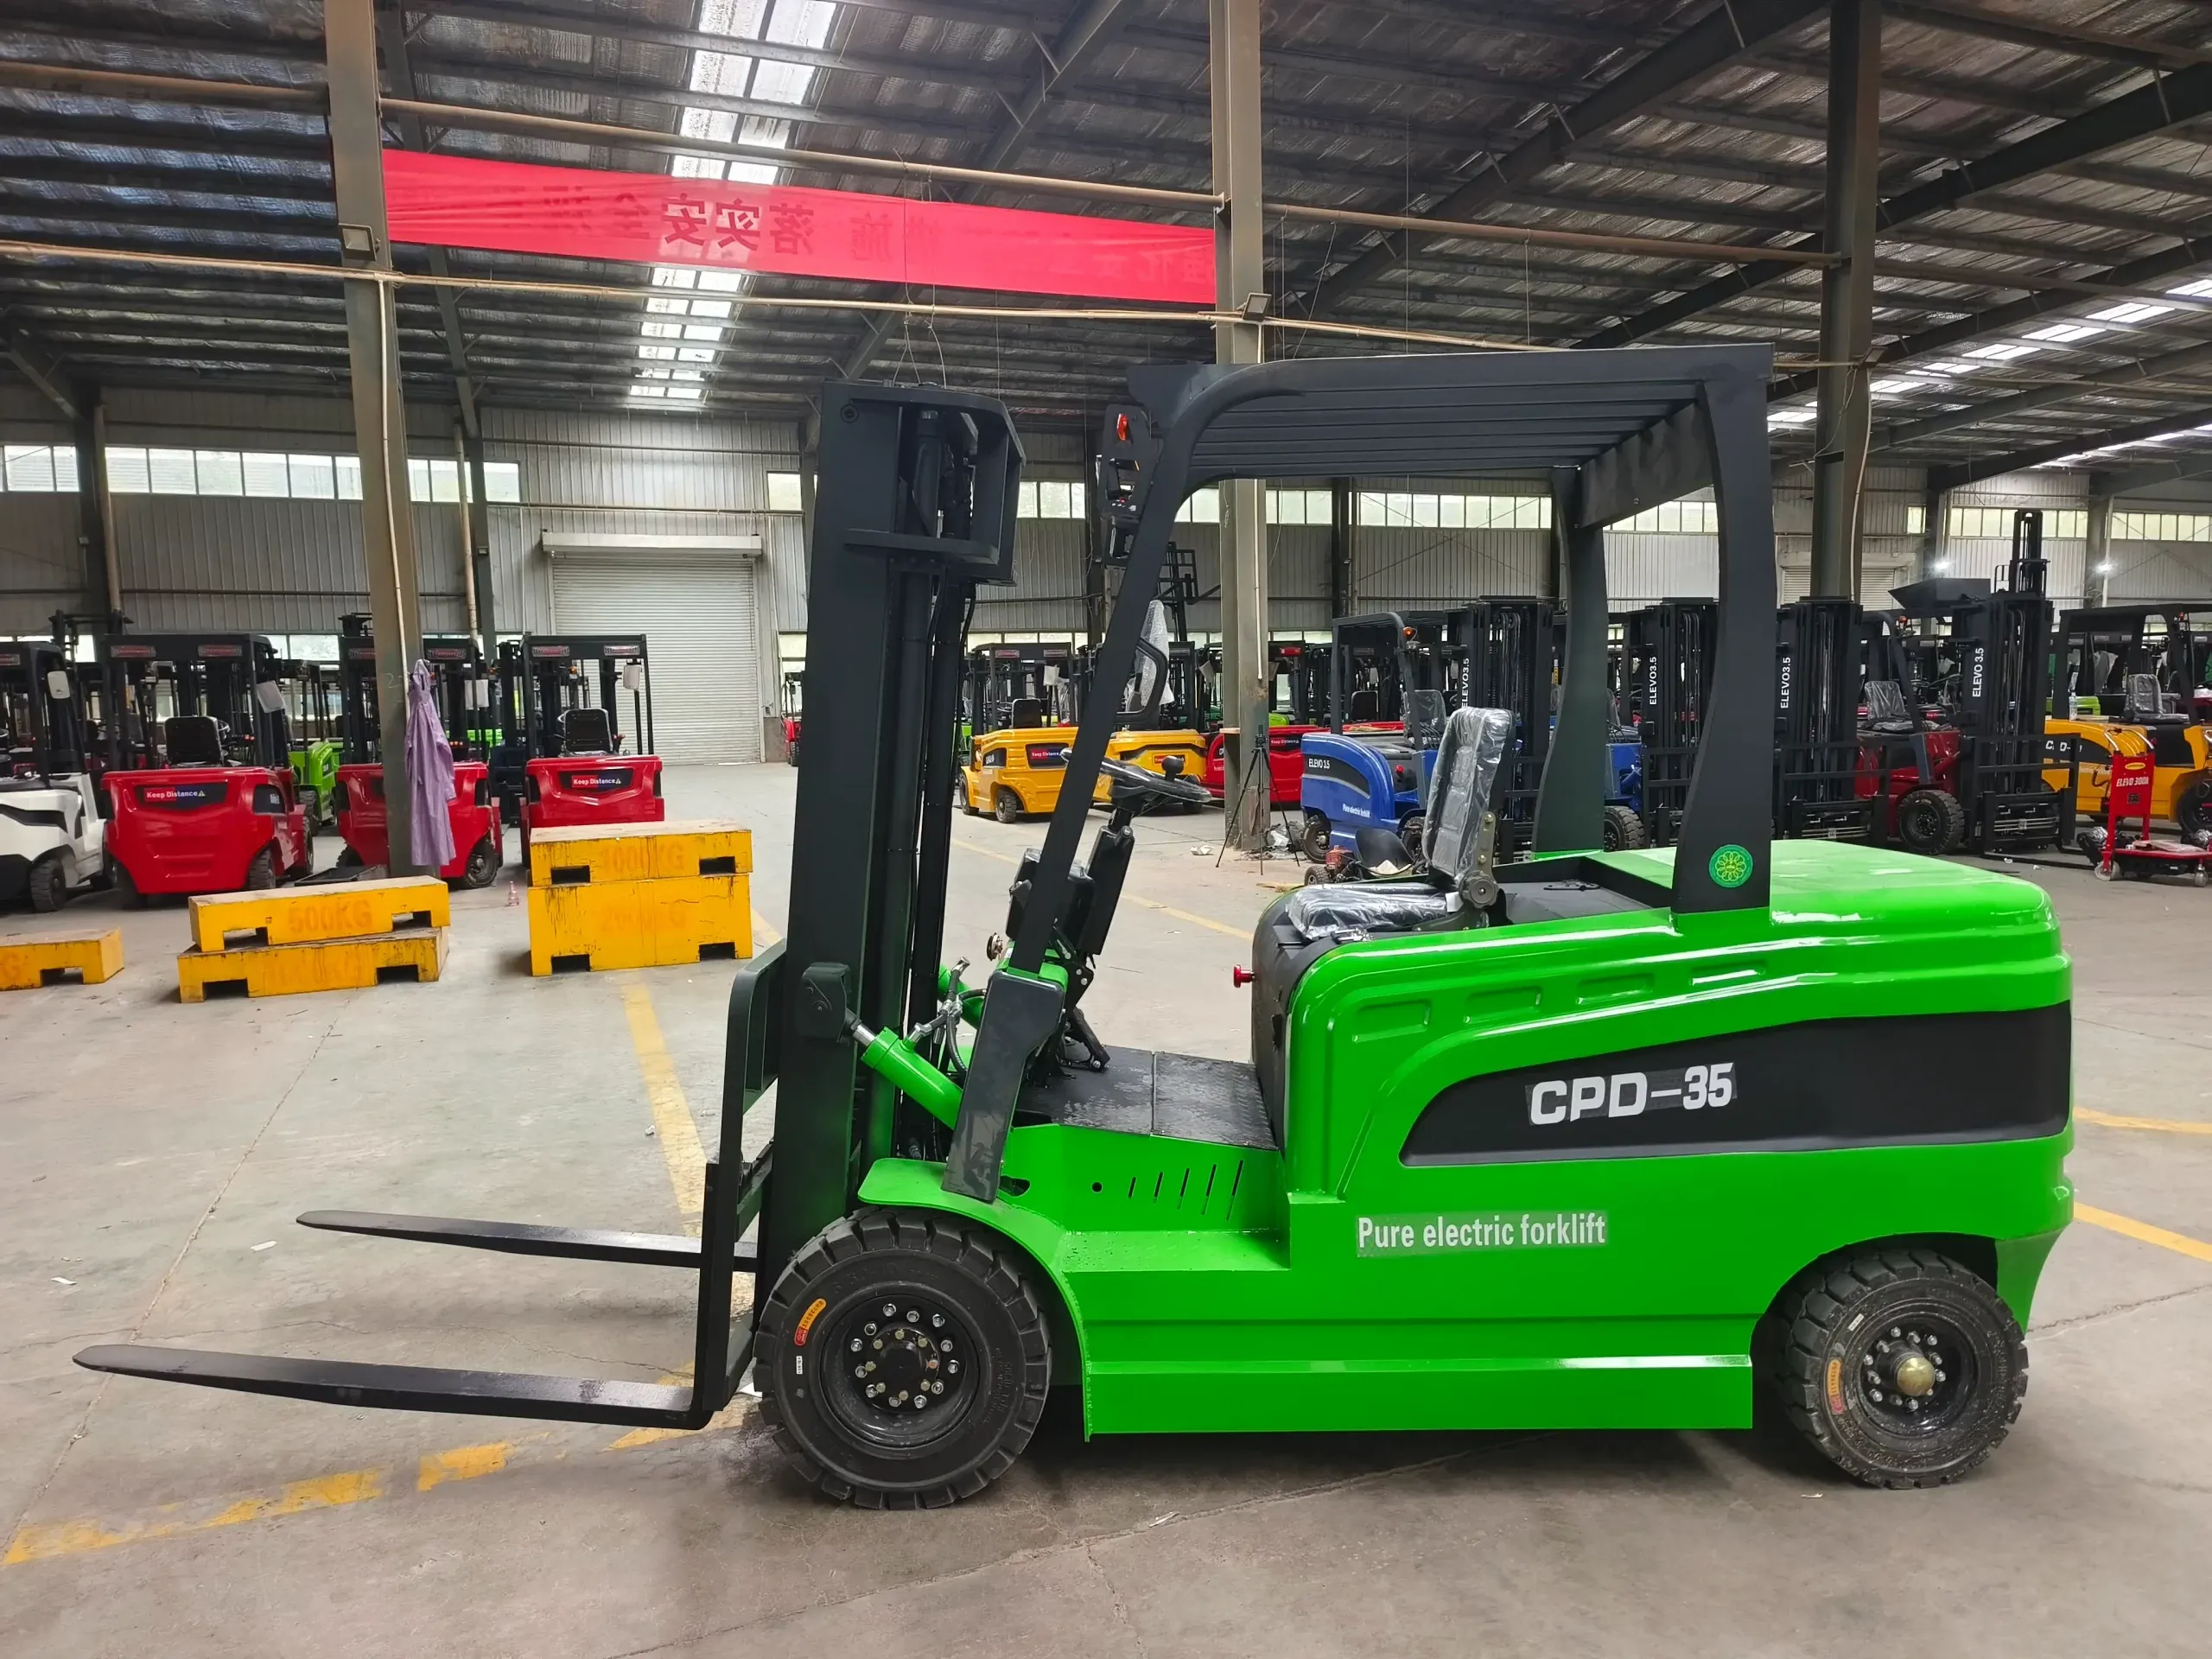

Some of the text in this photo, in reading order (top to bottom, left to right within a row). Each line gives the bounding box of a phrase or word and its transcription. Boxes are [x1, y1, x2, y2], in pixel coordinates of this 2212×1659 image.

[1973, 647, 1985, 697] ELEVO 3.5
[1308, 758, 1324, 769] ELEVO
[2116, 778, 2134, 787] ELEVO
[166, 790, 198, 798] Distance
[288, 899, 372, 932] 500KG
[1358, 1212, 1605, 1248] Pure electric forklift
